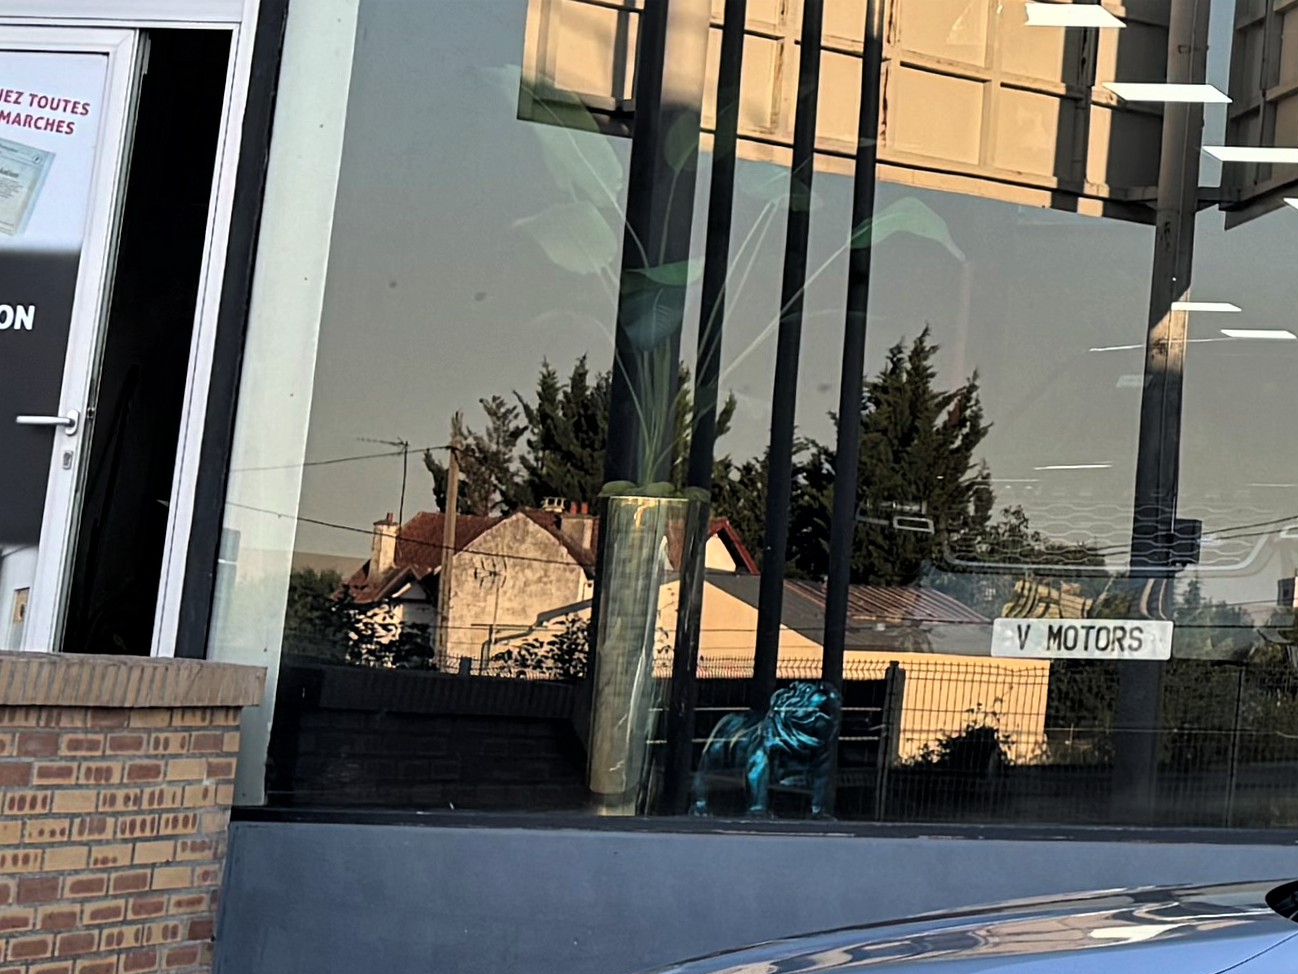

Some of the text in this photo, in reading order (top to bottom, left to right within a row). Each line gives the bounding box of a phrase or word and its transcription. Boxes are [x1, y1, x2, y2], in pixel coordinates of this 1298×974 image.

[29, 93, 90, 116] TOUTES
[0, 304, 35, 330] ON
[1017, 625, 1143, 651] V MOTORS
